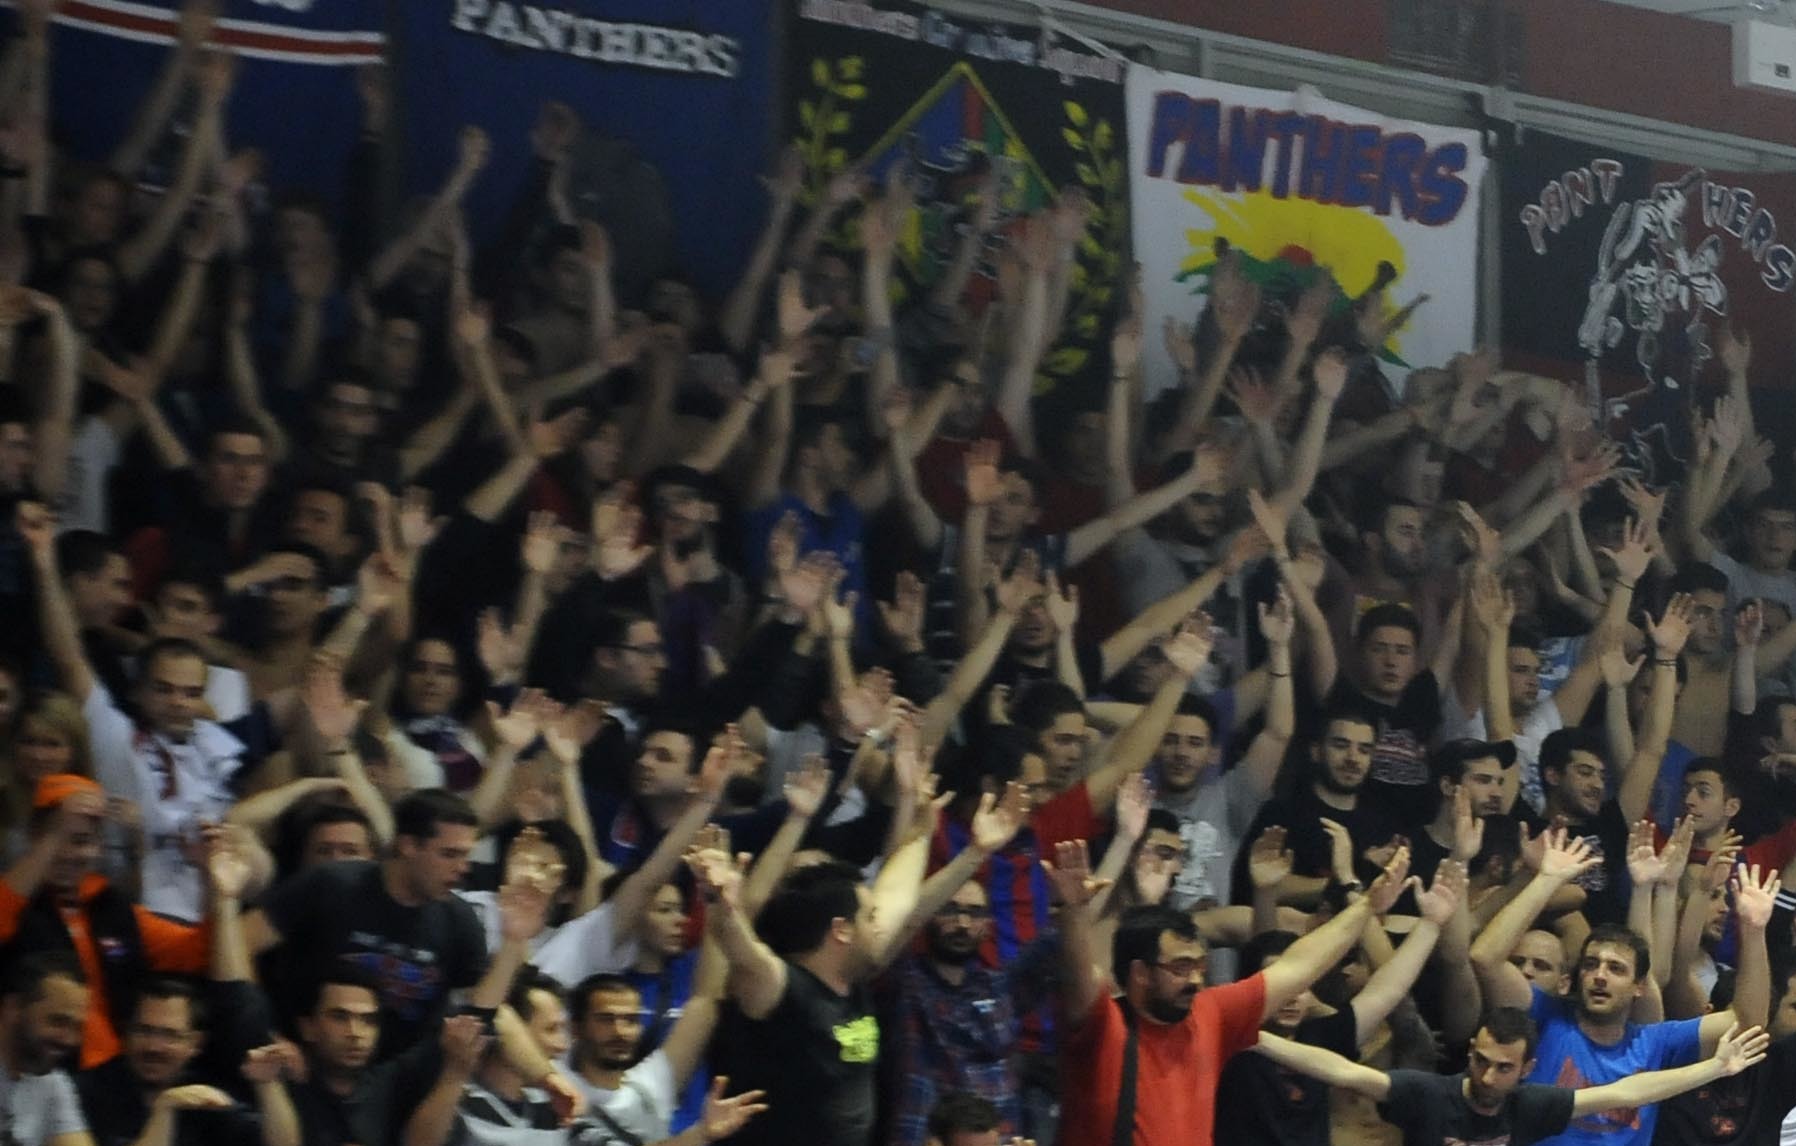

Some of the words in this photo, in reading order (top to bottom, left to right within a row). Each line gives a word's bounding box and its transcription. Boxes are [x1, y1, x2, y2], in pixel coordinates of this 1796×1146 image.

[450, 0, 738, 77] PANTHERS
[1146, 91, 1469, 227] PANTHERS
[1519, 158, 1624, 254] PANT
